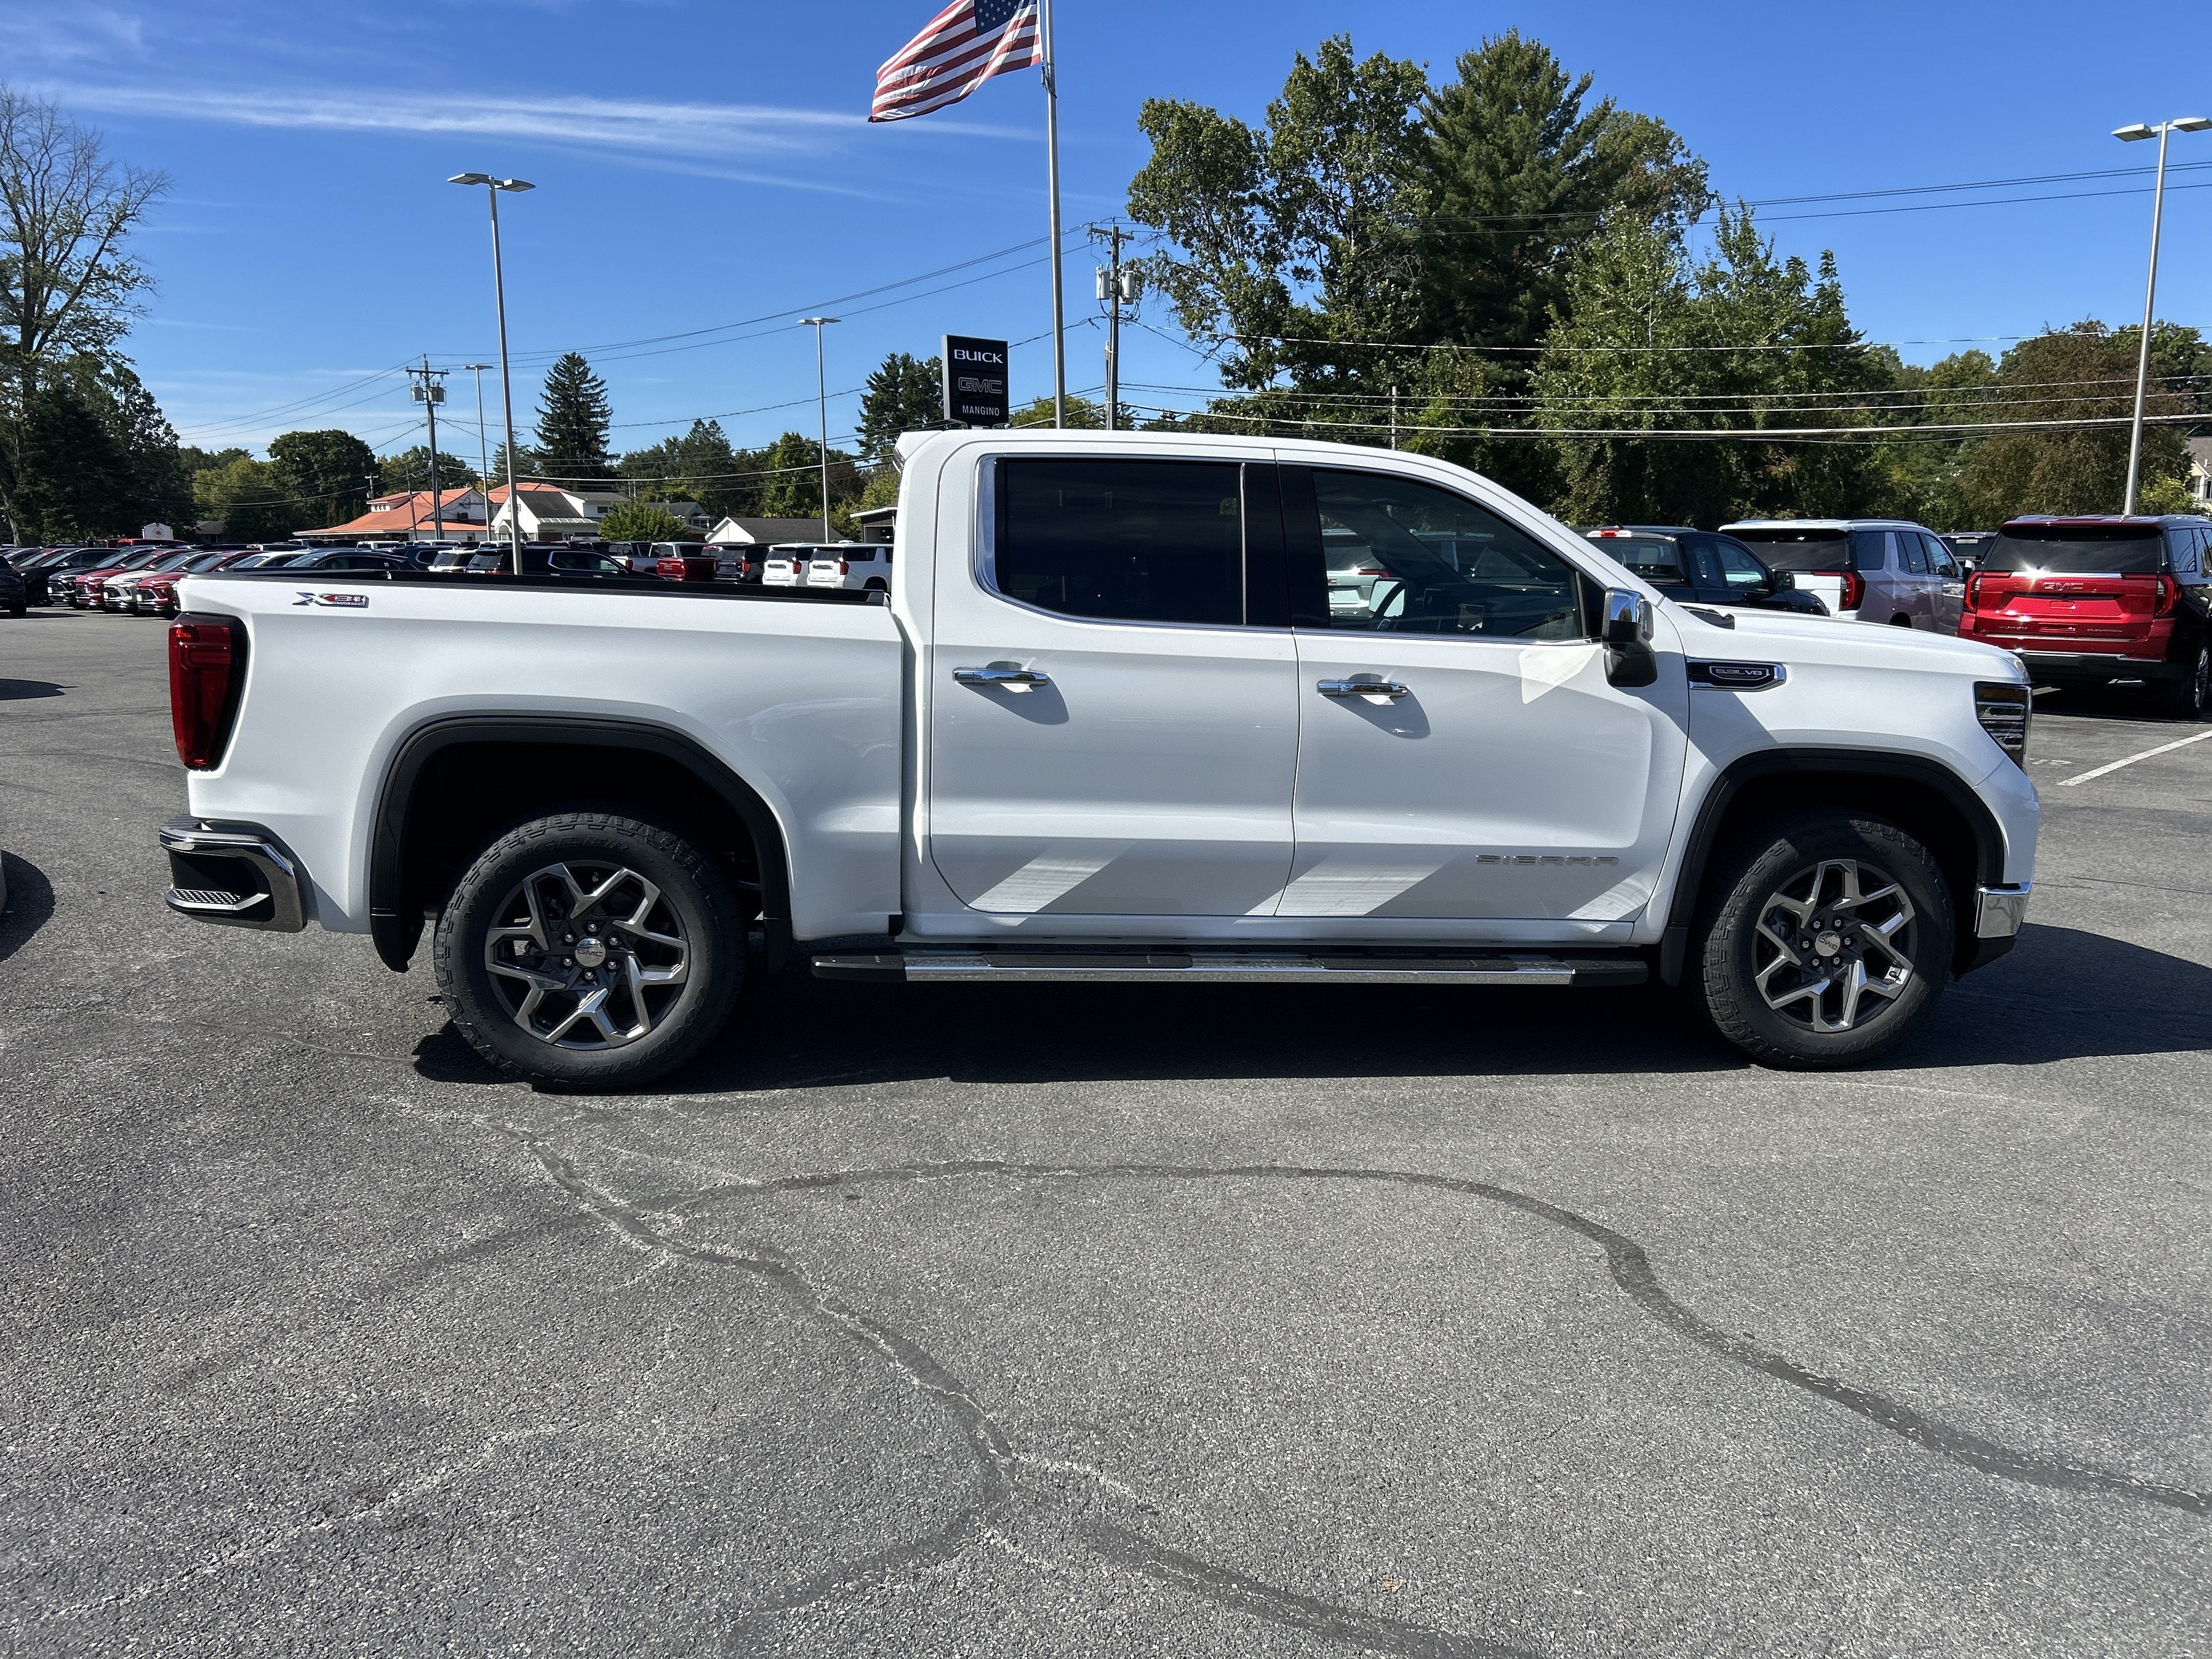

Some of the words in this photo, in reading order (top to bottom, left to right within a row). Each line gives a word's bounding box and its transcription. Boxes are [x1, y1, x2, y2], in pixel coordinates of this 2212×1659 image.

[954, 349, 1003, 363] BUICK
[958, 377, 1002, 394] GMC
[962, 405, 1000, 416] MANGINO
[2043, 582, 2084, 591] GMC
[1475, 854, 1619, 866] SIERRA
[1818, 935, 1838, 951] GMC
[577, 948, 603, 957] GMC
[539, 986, 708, 1076] GOODYEAR
